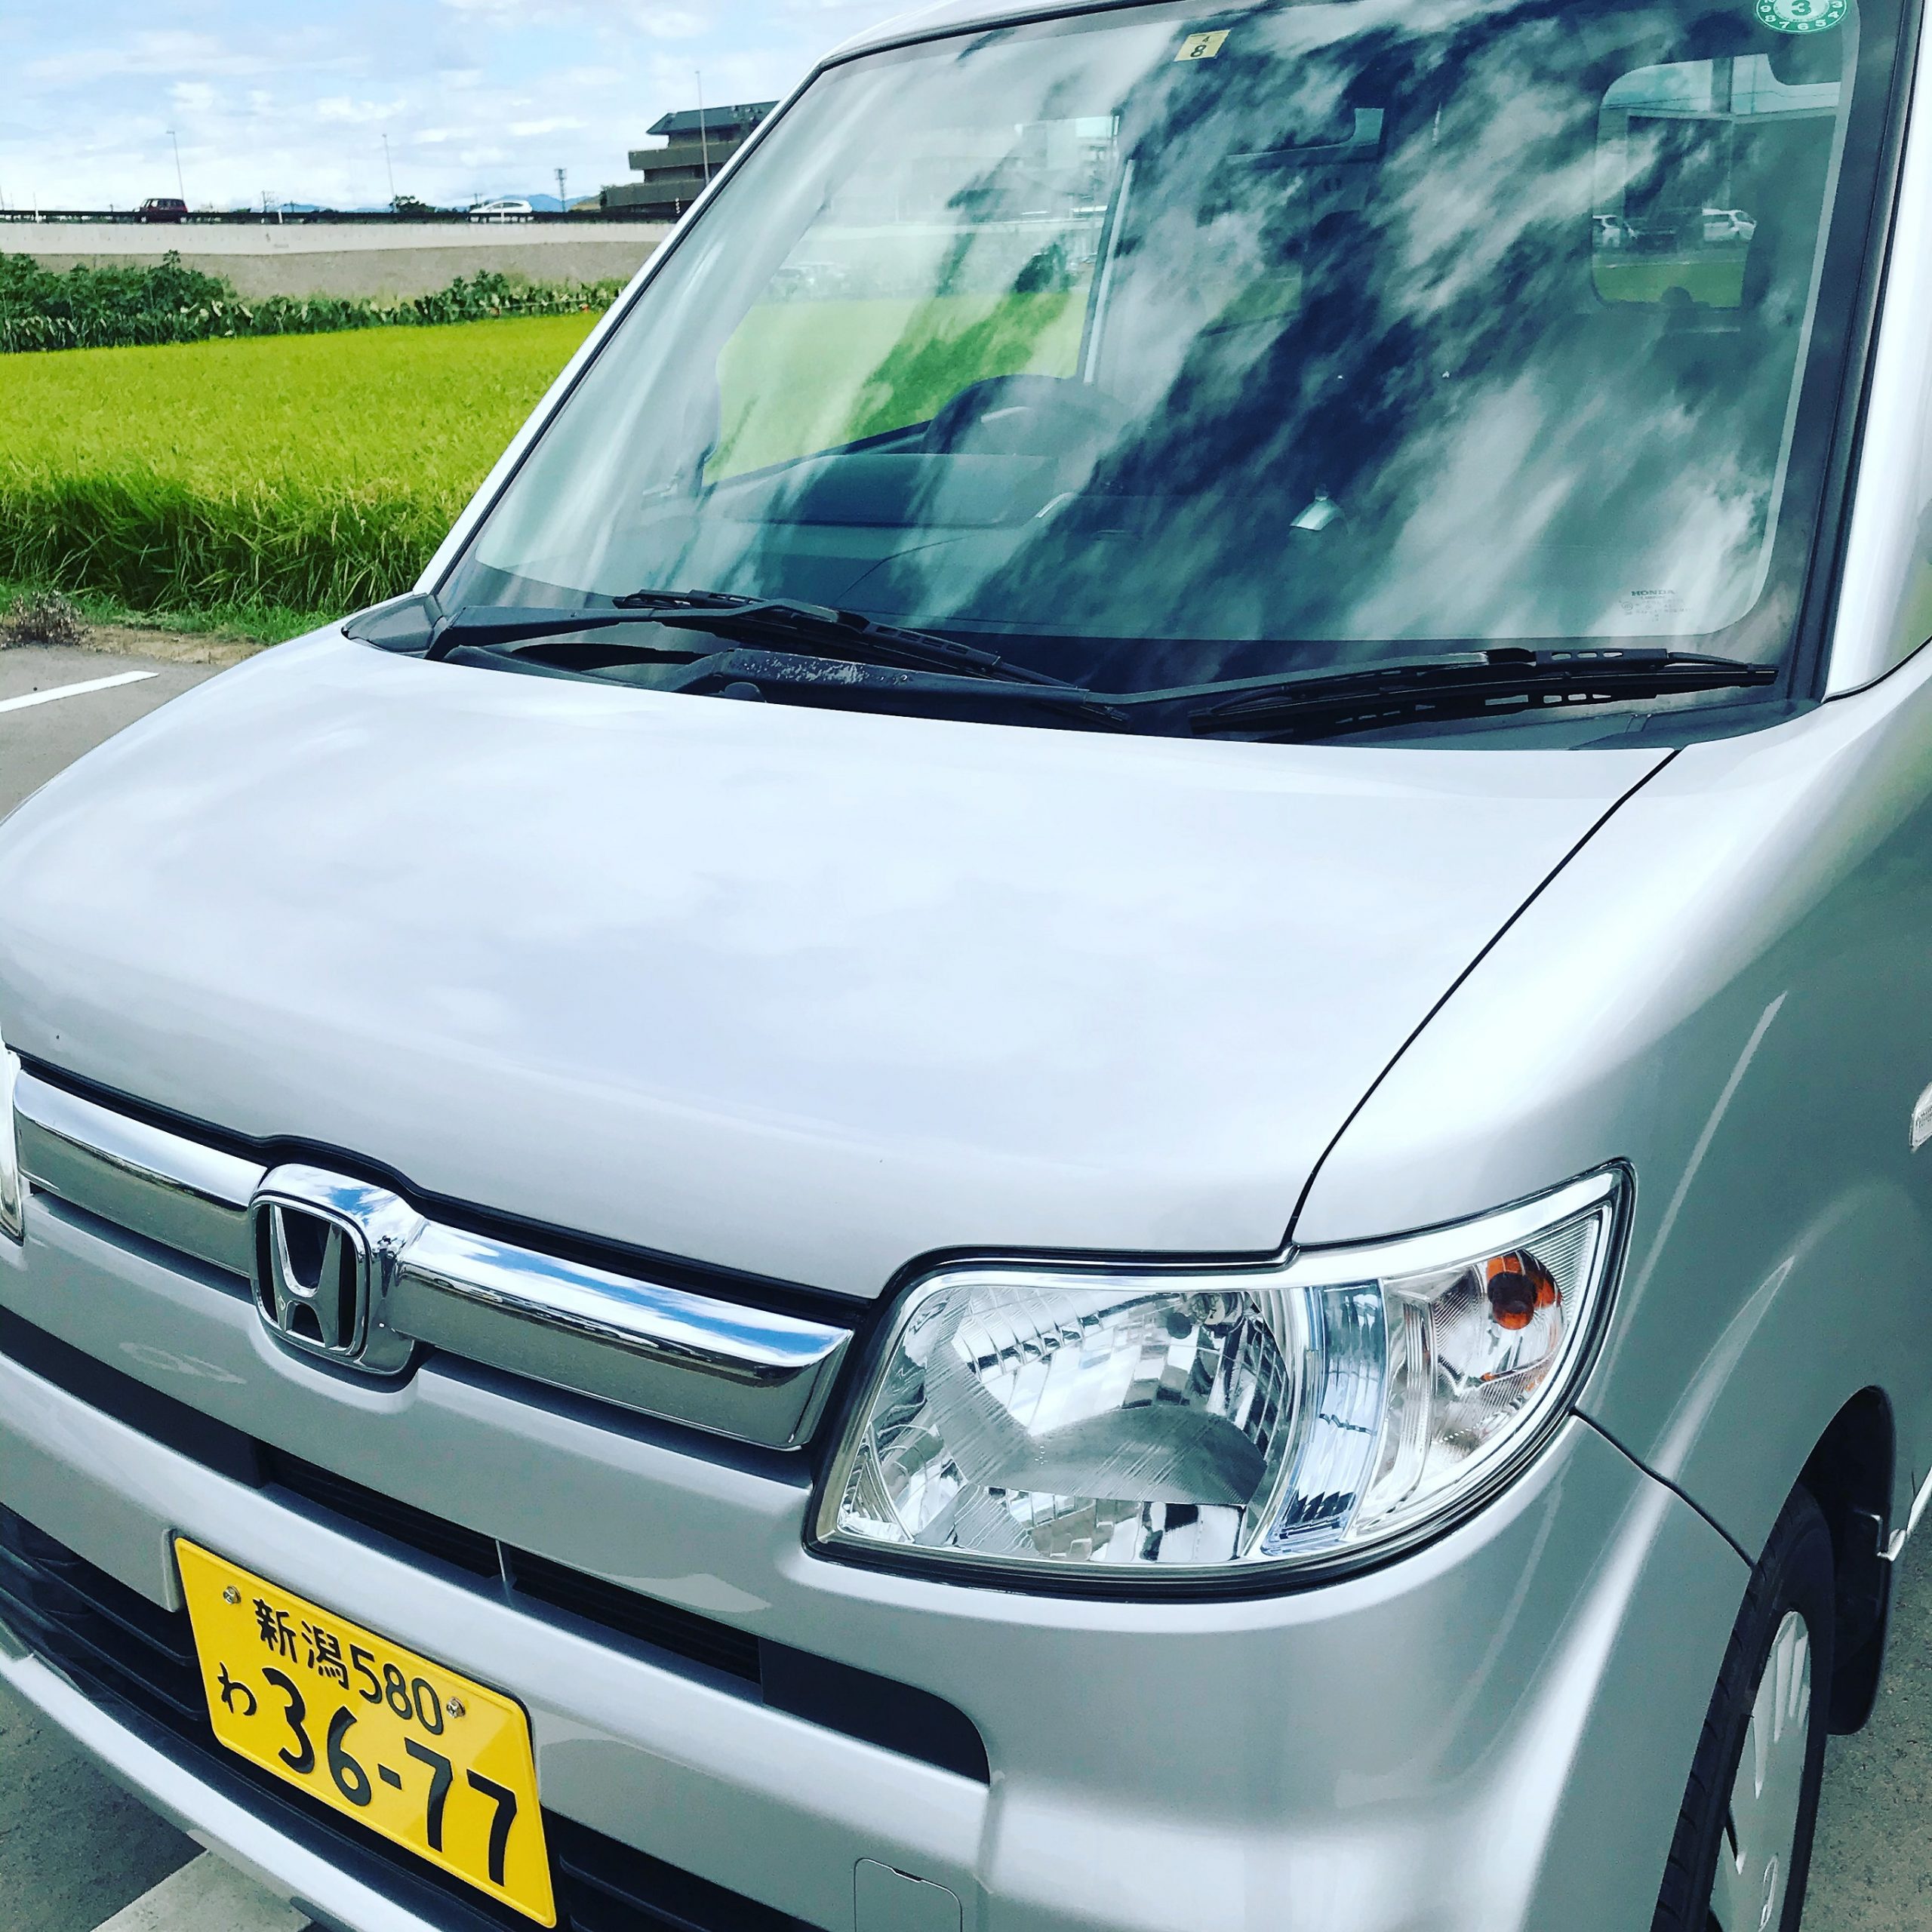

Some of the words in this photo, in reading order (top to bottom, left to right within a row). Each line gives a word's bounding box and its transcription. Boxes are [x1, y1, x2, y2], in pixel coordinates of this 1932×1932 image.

[1792, 0, 1812, 16] 3
[1815, 19, 1826, 27] 5
[1190, 45, 1206, 57] 8
[217, 1662, 257, 1716] わ
[262, 1667, 518, 1887] 36-77
